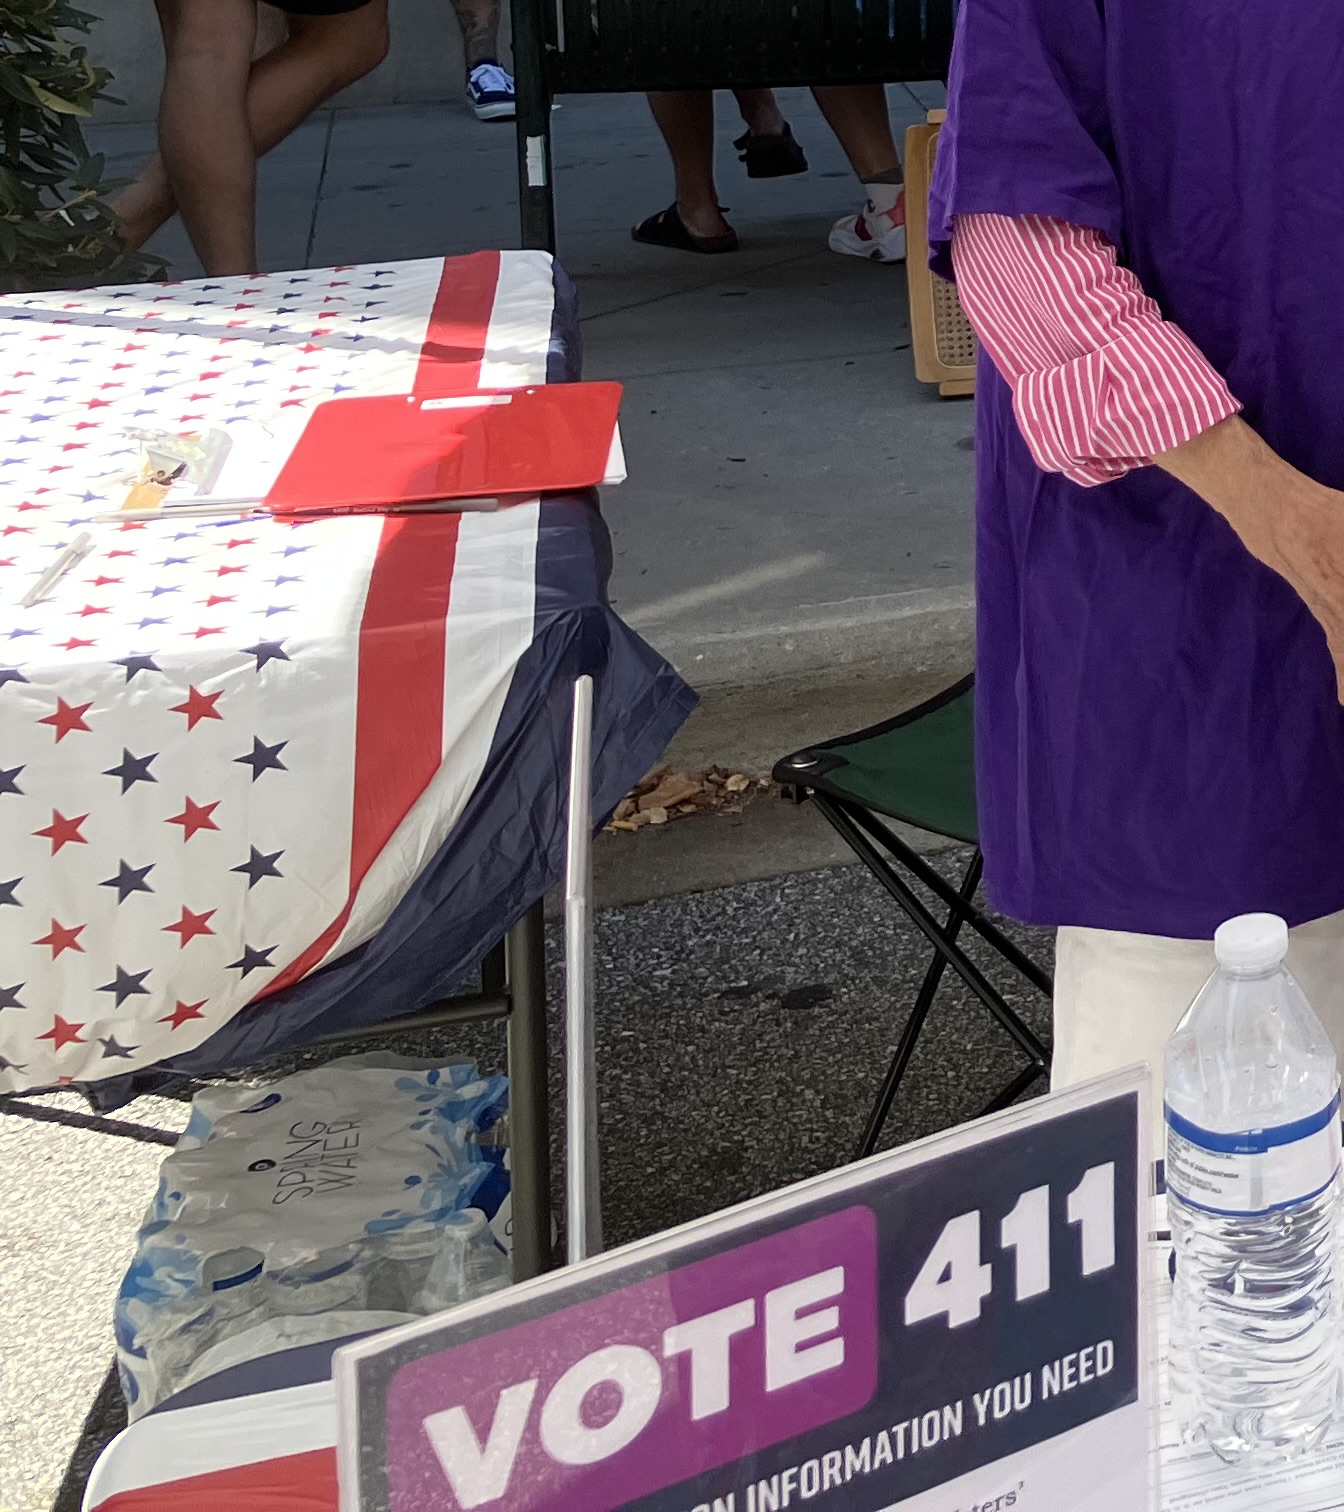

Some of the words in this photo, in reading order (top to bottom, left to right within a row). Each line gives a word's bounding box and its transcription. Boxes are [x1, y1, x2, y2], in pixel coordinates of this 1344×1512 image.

[315, 1119, 363, 1194] WATER
[422, 1266, 845, 1510] VOTE
[902, 1163, 1117, 1330] 411
[746, 1404, 963, 1512] INFORMATION
[974, 1371, 1032, 1427] YOU
[1041, 1339, 1115, 1400] NEED
